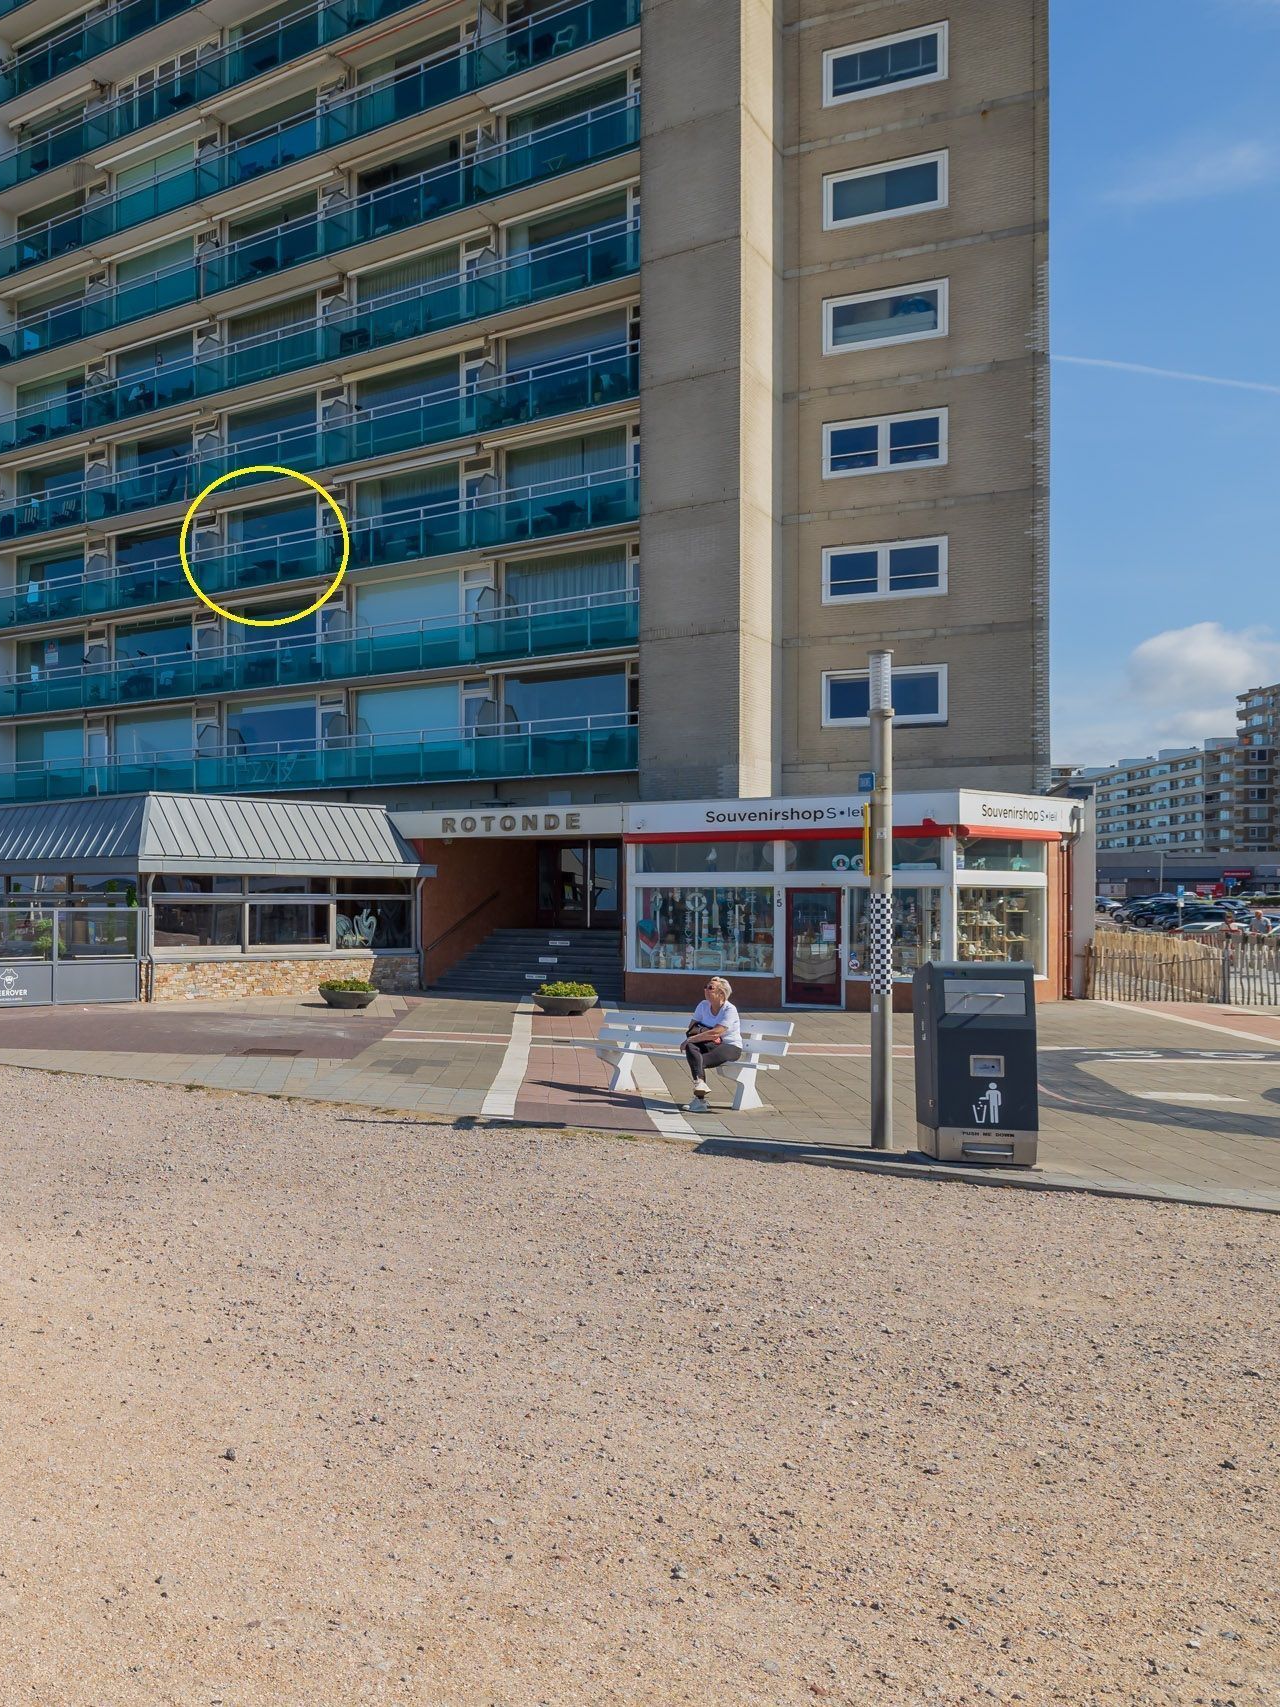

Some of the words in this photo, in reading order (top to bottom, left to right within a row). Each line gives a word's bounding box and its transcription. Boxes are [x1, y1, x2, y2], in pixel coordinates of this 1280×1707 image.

[705, 808, 824, 823] Souvenirshop
[981, 804, 1039, 822] Souvenirshop
[441, 813, 581, 833] ROTONDE
[776, 899, 783, 908] 5
